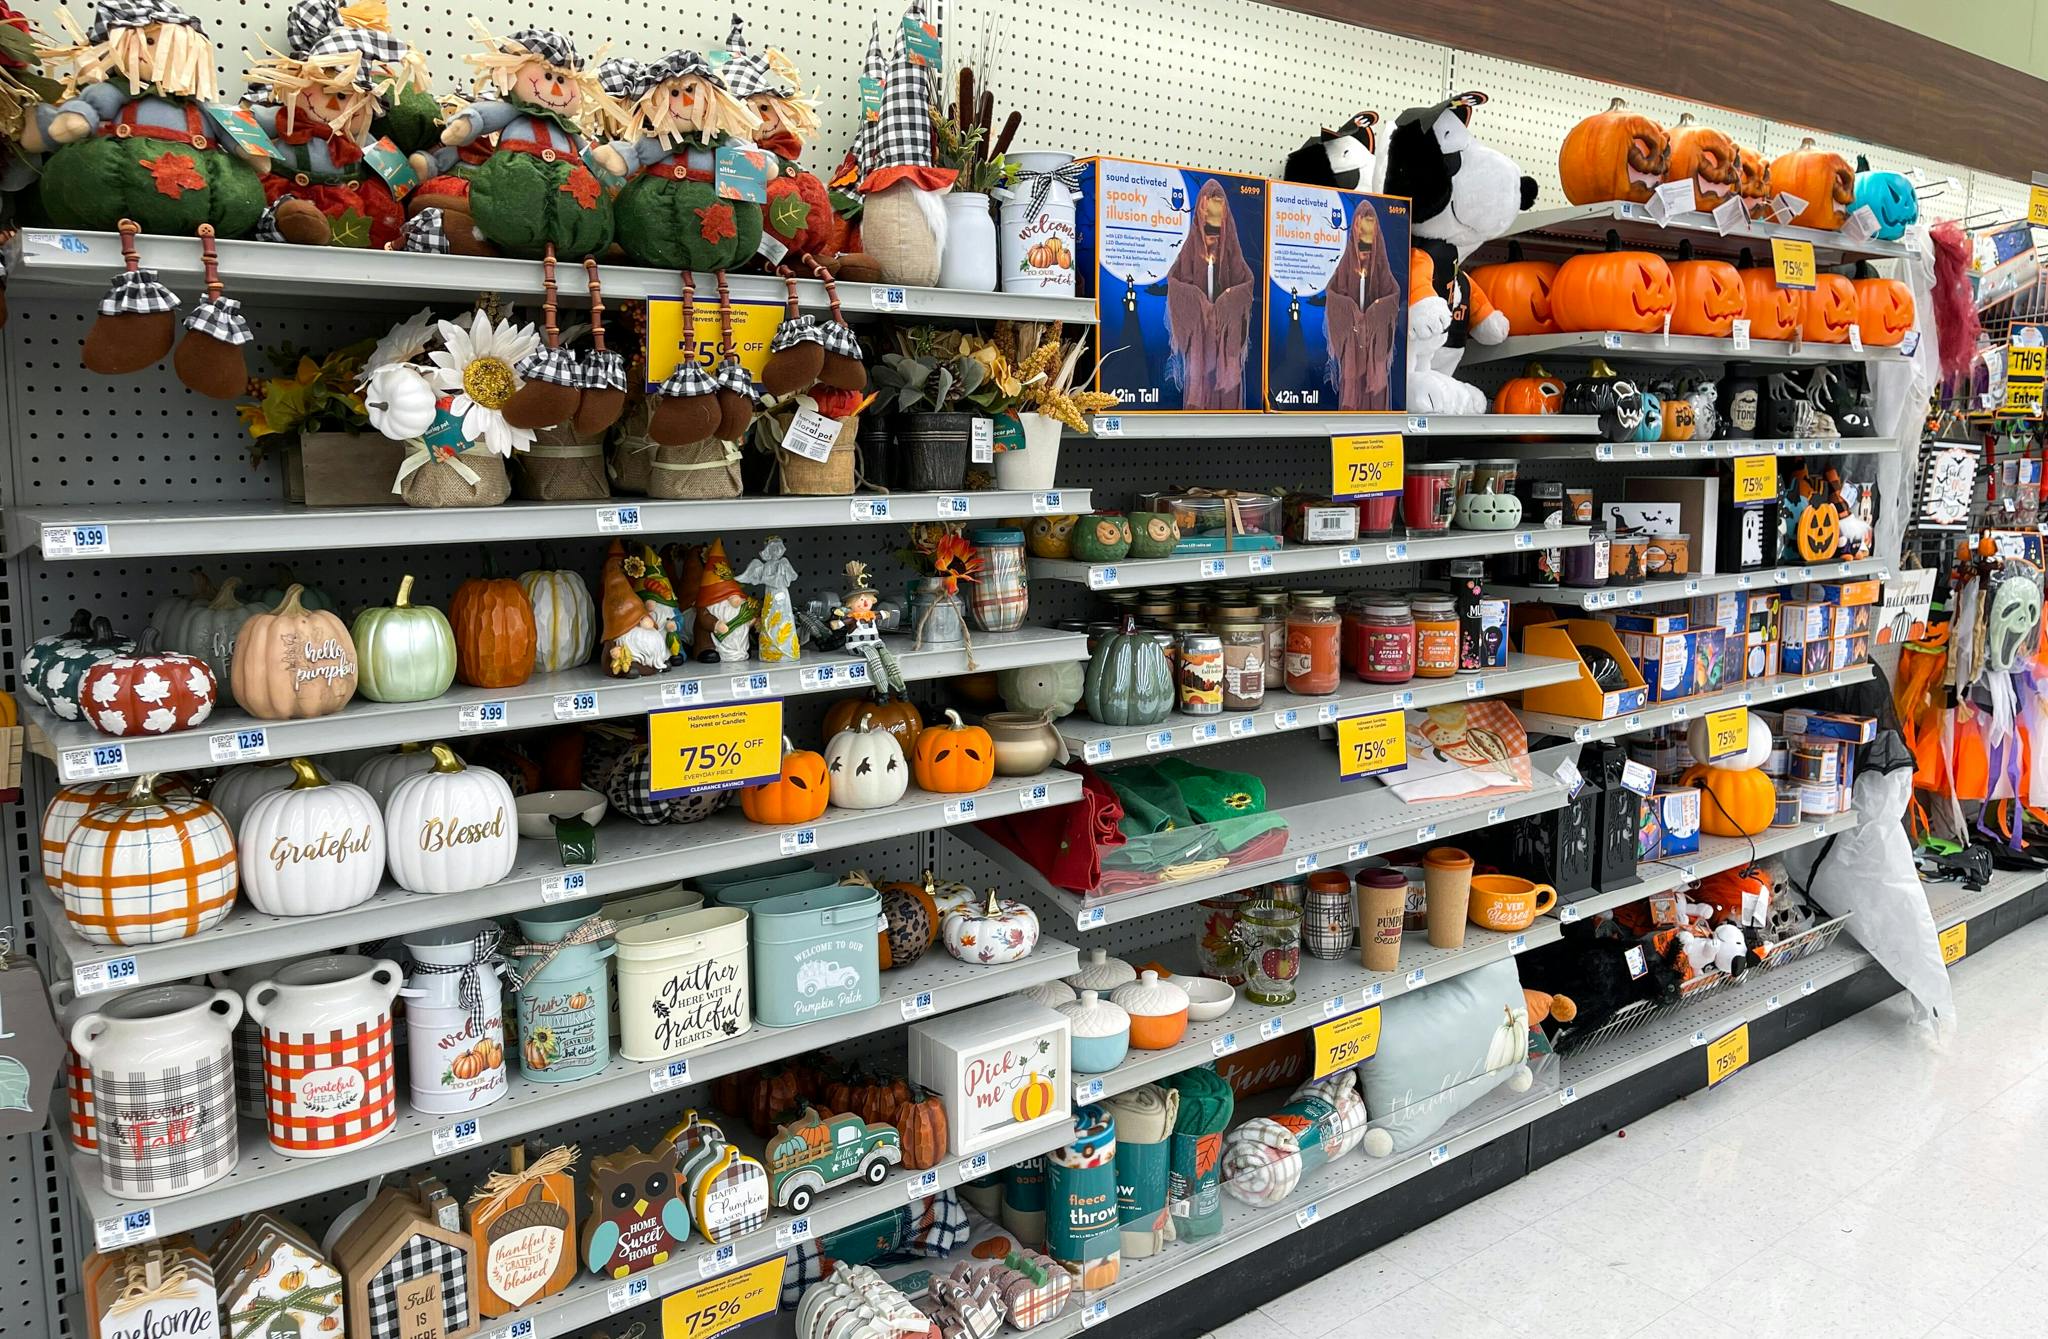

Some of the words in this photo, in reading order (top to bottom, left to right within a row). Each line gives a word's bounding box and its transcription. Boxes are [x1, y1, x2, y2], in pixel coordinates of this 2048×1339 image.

[1106, 173, 1130, 184] sound
[1132, 174, 1168, 188] activated
[1106, 188, 1148, 207] spooky
[1275, 195, 1296, 204] sound
[1297, 197, 1328, 208] activated
[1106, 205, 1148, 223] illusion
[1151, 208, 1183, 227] ghoul
[1275, 209, 1312, 226] spooky
[1019, 213, 1077, 241] welcome
[1275, 224, 1313, 240] illusion
[1313, 230, 1341, 244] ghoul
[1782, 260, 1803, 276] 75%
[1041, 271, 1074, 288] patch
[887, 290, 903, 303] 12.99
[743, 342, 764, 352] OFF
[2013, 351, 2042, 372] THIS
[1138, 388, 1159, 403] Tall
[1275, 390, 1299, 403] 42in
[1300, 390, 1319, 403] Tall
[2013, 392, 2039, 404] Enter
[818, 430, 833, 442] pot
[1348, 461, 1382, 482] 75%
[1382, 460, 1394, 468] OFF
[1743, 475, 1763, 493] 75%
[951, 500, 966, 512] 12.99
[1046, 494, 1060, 506] 12.99
[618, 510, 638, 524] 14.99
[870, 504, 887, 516] 7.99
[53, 536, 67, 544] PRICE
[73, 530, 103, 546] 19.99
[1105, 567, 1117, 579] 7.99
[1886, 593, 1930, 608] HALLOWEEN
[304, 638, 342, 663] hello
[295, 654, 356, 690] pumpkin
[818, 667, 834, 680] 7.99
[849, 666, 865, 679] 6.99
[681, 682, 699, 696] 7.99
[750, 676, 767, 690] 12.99
[573, 696, 594, 710] 9.99
[480, 707, 502, 720] 9.99
[687, 713, 719, 723] Halloween
[720, 710, 748, 721] Sundries,
[690, 722, 712, 731] Harvest
[723, 718, 746, 728] Candles
[218, 741, 233, 749] PRICE
[238, 733, 264, 750] 12.99
[1717, 729, 1736, 747] 75%
[93, 749, 122, 766] 12.99
[680, 742, 742, 772] 75%
[743, 738, 764, 750] OFF
[1354, 739, 1386, 763] 75%
[1386, 737, 1397, 745] OFF
[72, 757, 87, 765] PRICE
[684, 771, 714, 781] EVERYDAY
[716, 768, 734, 778] PRICE
[690, 784, 721, 794] CLEARANCE
[722, 780, 745, 791] SAVINGS
[1033, 787, 1046, 799] 5.99
[960, 800, 974, 813] 12.99
[419, 806, 505, 853] Blessed
[797, 831, 814, 845] 12.99
[269, 824, 372, 872] Grateful
[563, 875, 584, 890] 7.99
[1487, 906, 1530, 921] Blessed
[1493, 901, 1503, 910] SO
[1506, 901, 1525, 911] VERY
[794, 942, 834, 963] WELCOME
[836, 940, 847, 951] TO
[849, 940, 865, 953] OUR
[1945, 944, 1959, 957] 75%
[83, 971, 98, 980] PRICE
[107, 961, 135, 980] 19.99
[662, 958, 739, 1003] gather
[677, 992, 705, 1009] HERE
[706, 984, 732, 1002] WITH
[794, 999, 835, 1017] Pumpkin
[838, 992, 862, 1010] Patch
[916, 994, 931, 1008] 17.99
[526, 994, 562, 1025] Fresh
[540, 1009, 596, 1027] PUMPKINS
[654, 988, 744, 1051] grateful
[675, 1028, 713, 1048] HEARTS
[562, 1048, 577, 1059] hot
[577, 1044, 597, 1057] cider
[1329, 1038, 1360, 1064] 75%
[1361, 1033, 1372, 1043] OFF
[668, 1061, 687, 1078] 12.99
[1717, 1052, 1736, 1072] 75%
[965, 1050, 1017, 1097] Pick
[302, 1074, 356, 1103] Grateful
[451, 1082, 464, 1091] TO
[466, 1076, 485, 1088] OUR
[313, 1089, 352, 1105] HEART
[976, 1083, 1006, 1109] me
[121, 1101, 196, 1122] WELCOME
[454, 1120, 476, 1139] 9.99
[127, 1116, 196, 1161] Fall
[841, 1157, 860, 1169] FALL
[971, 1155, 986, 1169] 9.99
[921, 1172, 936, 1186] 7.99
[710, 1187, 738, 1201] HAPPY
[1069, 1194, 1106, 1207] fleece
[709, 1193, 764, 1215] Pumpkin
[124, 1212, 151, 1231] 14.99
[714, 1211, 743, 1225] SEASON
[1069, 1203, 1118, 1226] throw
[630, 1216, 657, 1232] HOME
[792, 1220, 808, 1235] 9.99
[495, 1229, 547, 1261] thankful
[618, 1225, 664, 1258] Sweet
[628, 1244, 658, 1262] HOME
[716, 1245, 733, 1261] 9.99
[505, 1253, 544, 1271] GRATEFUL
[503, 1259, 549, 1291] blessed
[629, 1279, 647, 1296] 7.99
[404, 1286, 436, 1311] Fall
[685, 1296, 741, 1336] 75%
[744, 1287, 765, 1299] OFF
[416, 1315, 427, 1327] IS
[511, 1320, 531, 1338] 9.99
